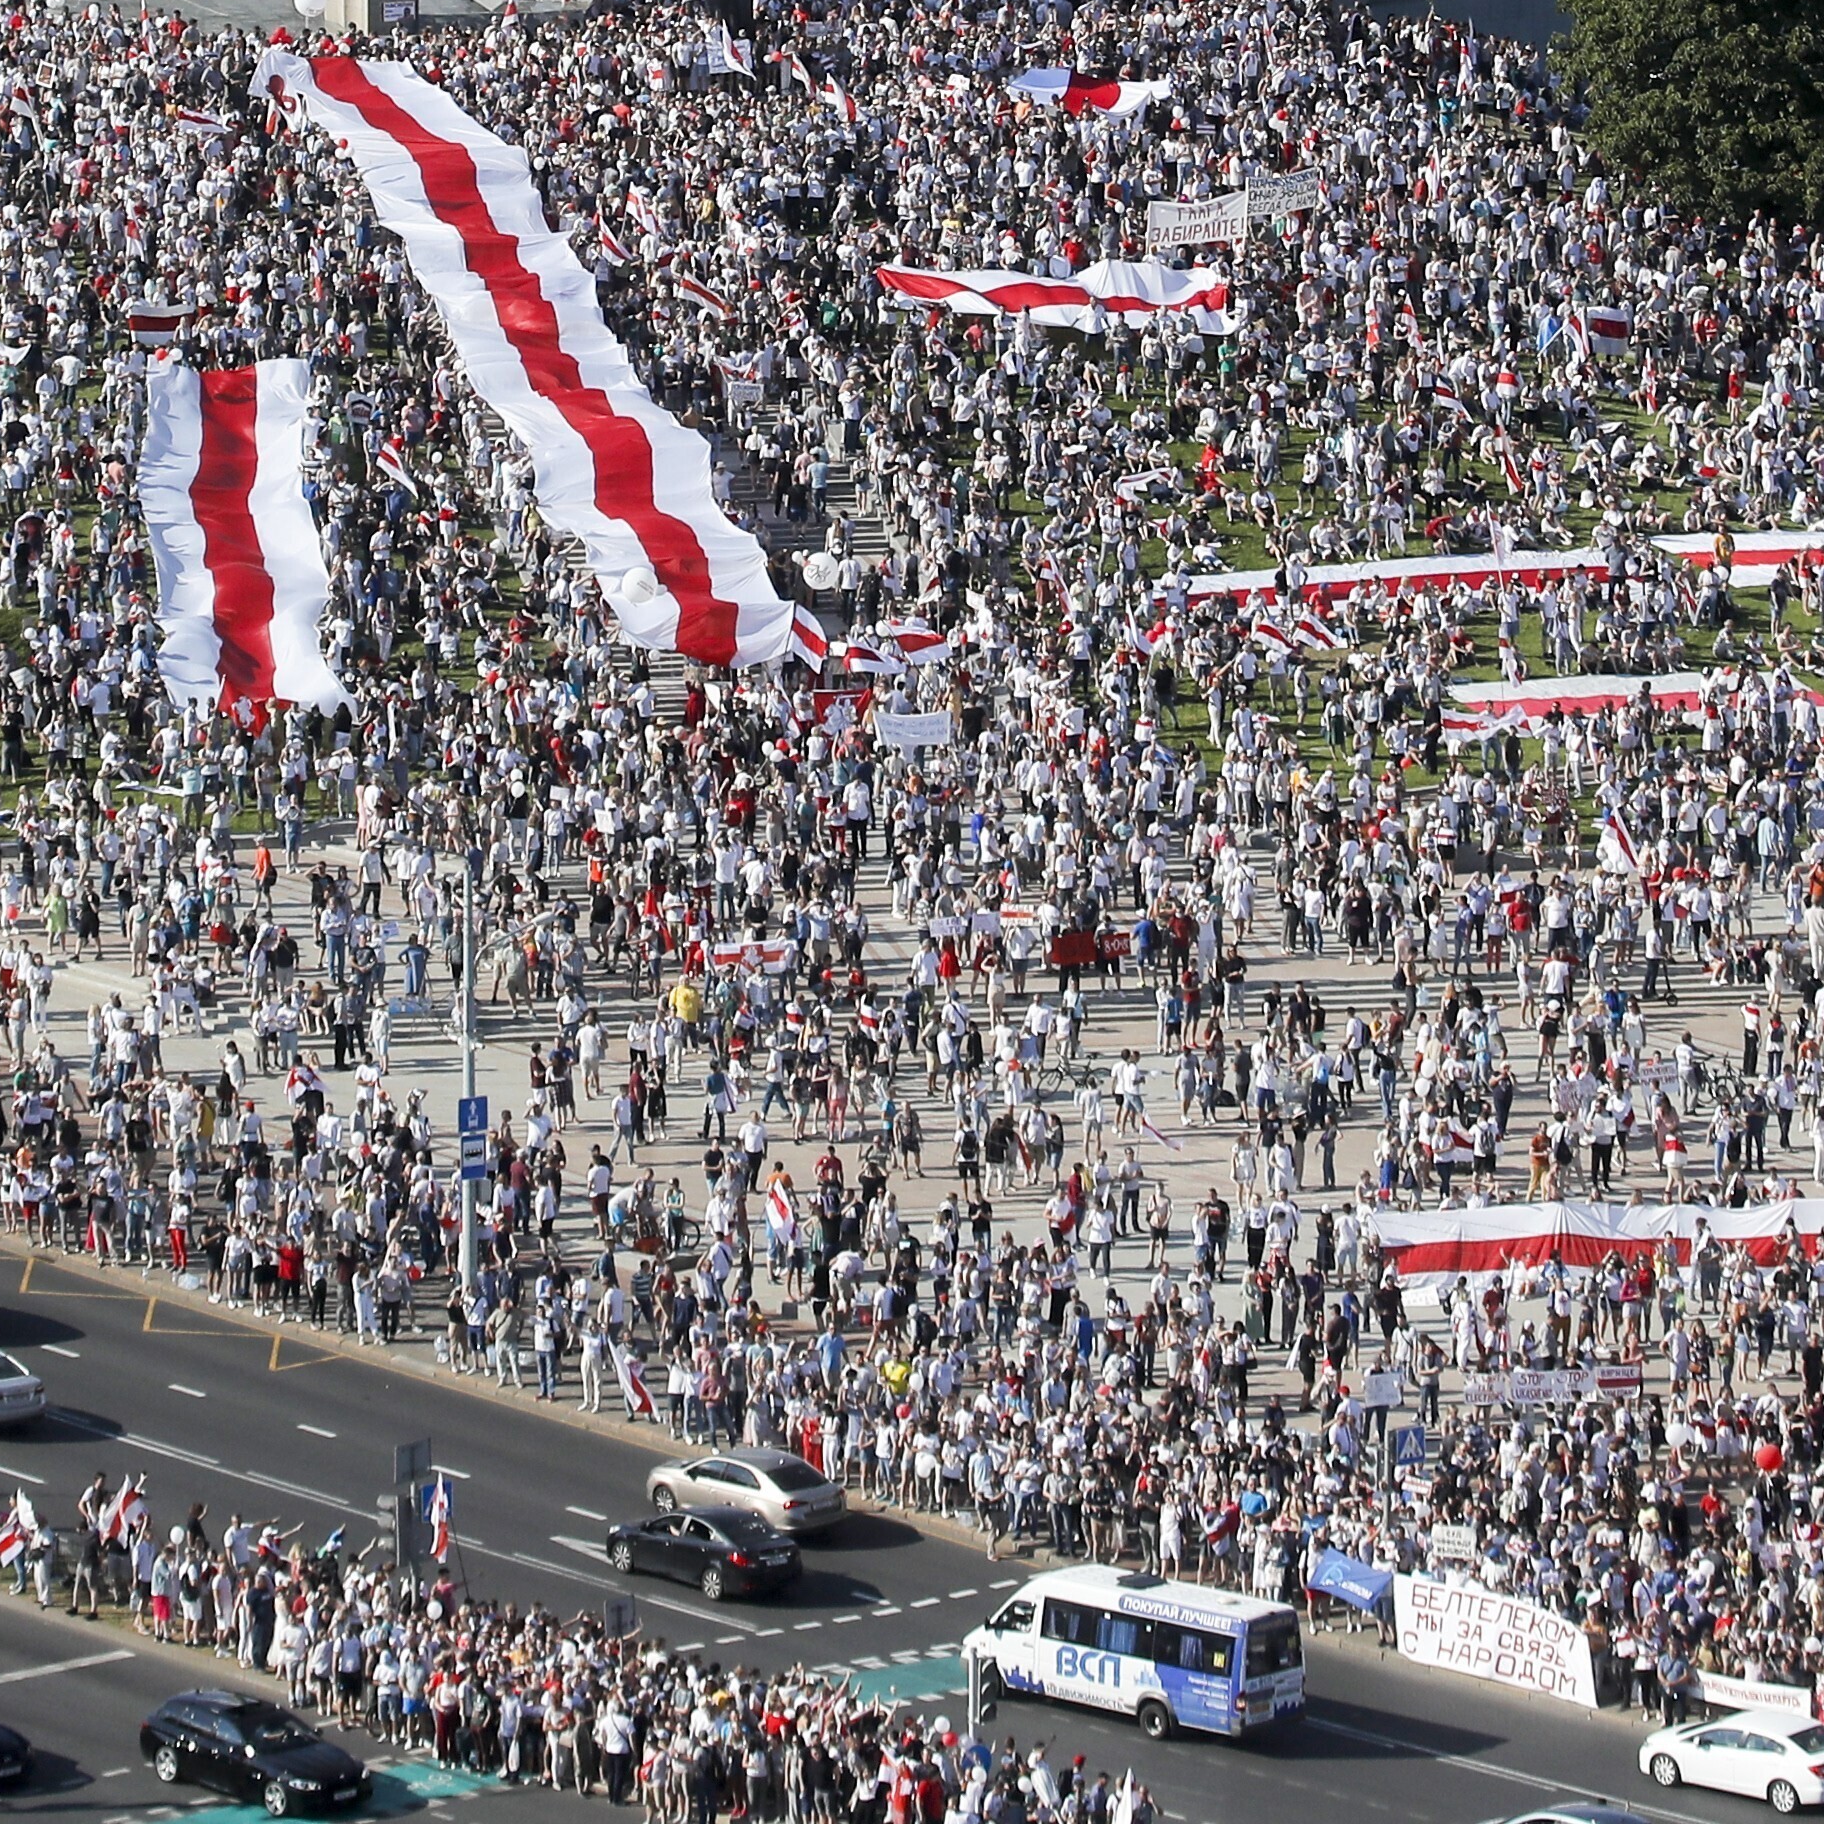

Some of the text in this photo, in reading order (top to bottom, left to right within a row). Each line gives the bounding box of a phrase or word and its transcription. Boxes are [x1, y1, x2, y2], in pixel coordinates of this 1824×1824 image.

[1150, 217, 1245, 243] ЗАБИРАЙТЕ!
[1517, 1371, 1545, 1386] STOP
[1556, 1370, 1589, 1384] STOP
[1123, 1596, 1232, 1631] ПОКУПАЙ ЛУЧШЕЕ!
[1411, 1583, 1576, 1651] БЕЛТЕЛЕКОМ
[1416, 1610, 1566, 1668] МЫ ЗА СВЯЗЬ
[1056, 1645, 1121, 1688] ВСП
[1403, 1630, 1577, 1696] С НАРОДОМ
